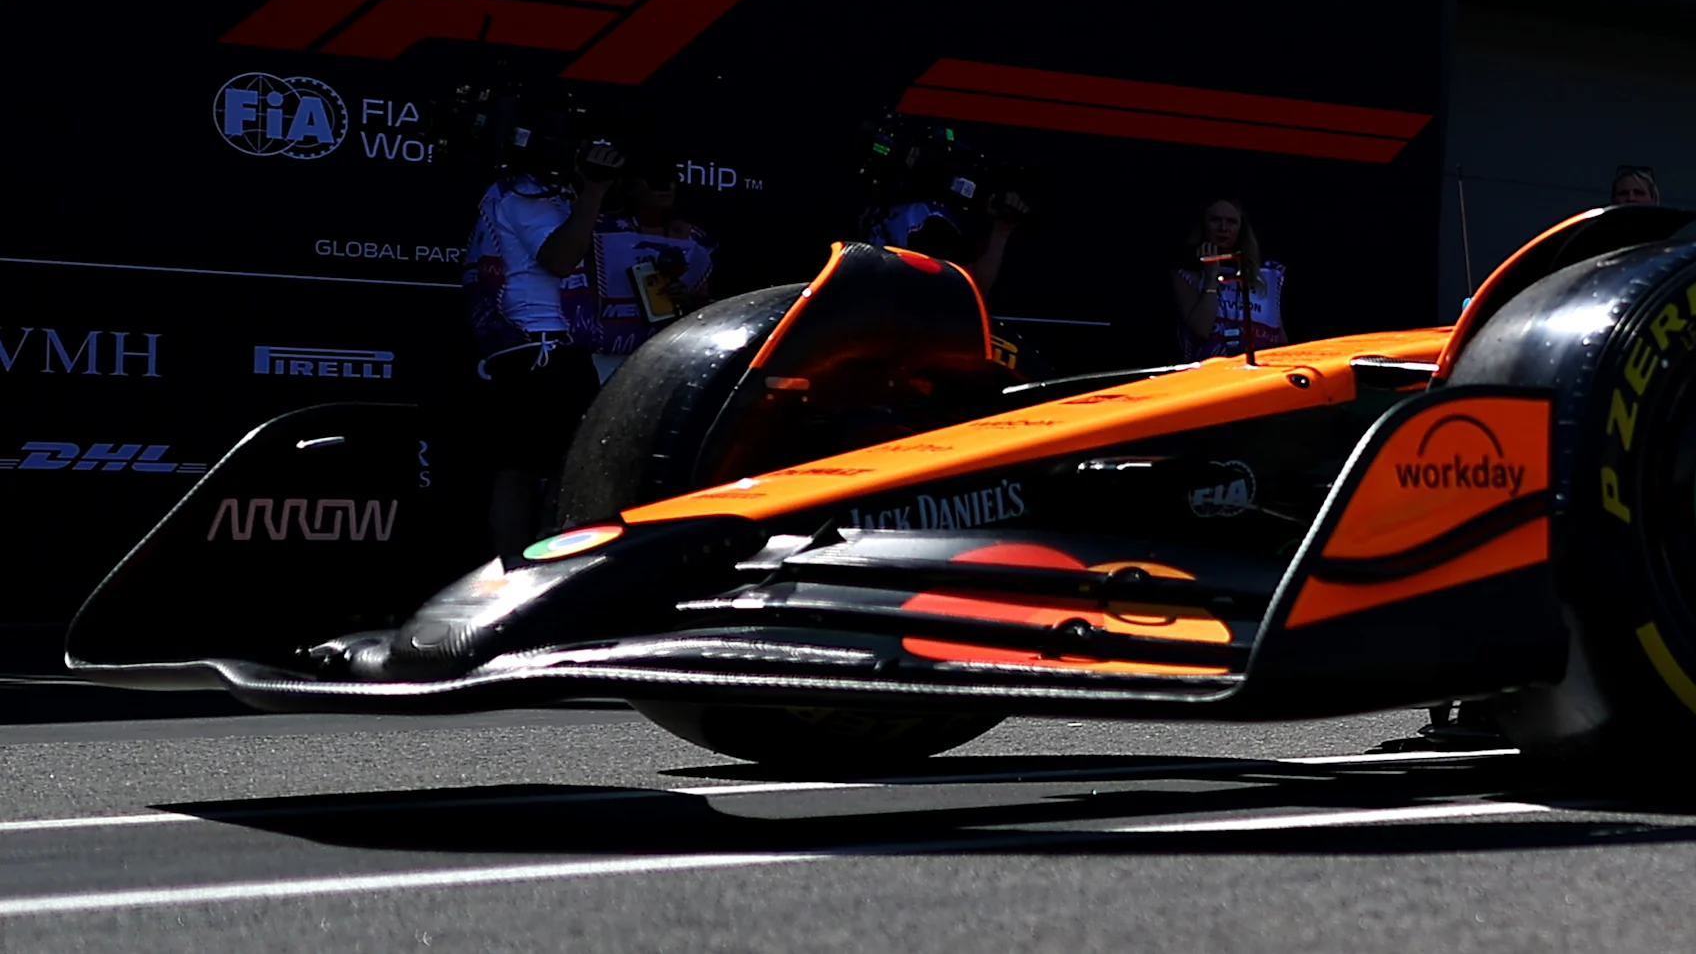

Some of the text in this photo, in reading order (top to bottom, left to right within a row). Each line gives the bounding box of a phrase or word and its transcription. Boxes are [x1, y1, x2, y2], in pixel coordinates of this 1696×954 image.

[362, 99, 420, 127] FIA
[314, 239, 409, 262] GLOBAL
[0, 325, 164, 378] VMH
[253, 345, 396, 380] PIRELLI
[17, 441, 180, 474] DHL
[1395, 453, 1526, 498] workday
[1600, 465, 1633, 526] P
